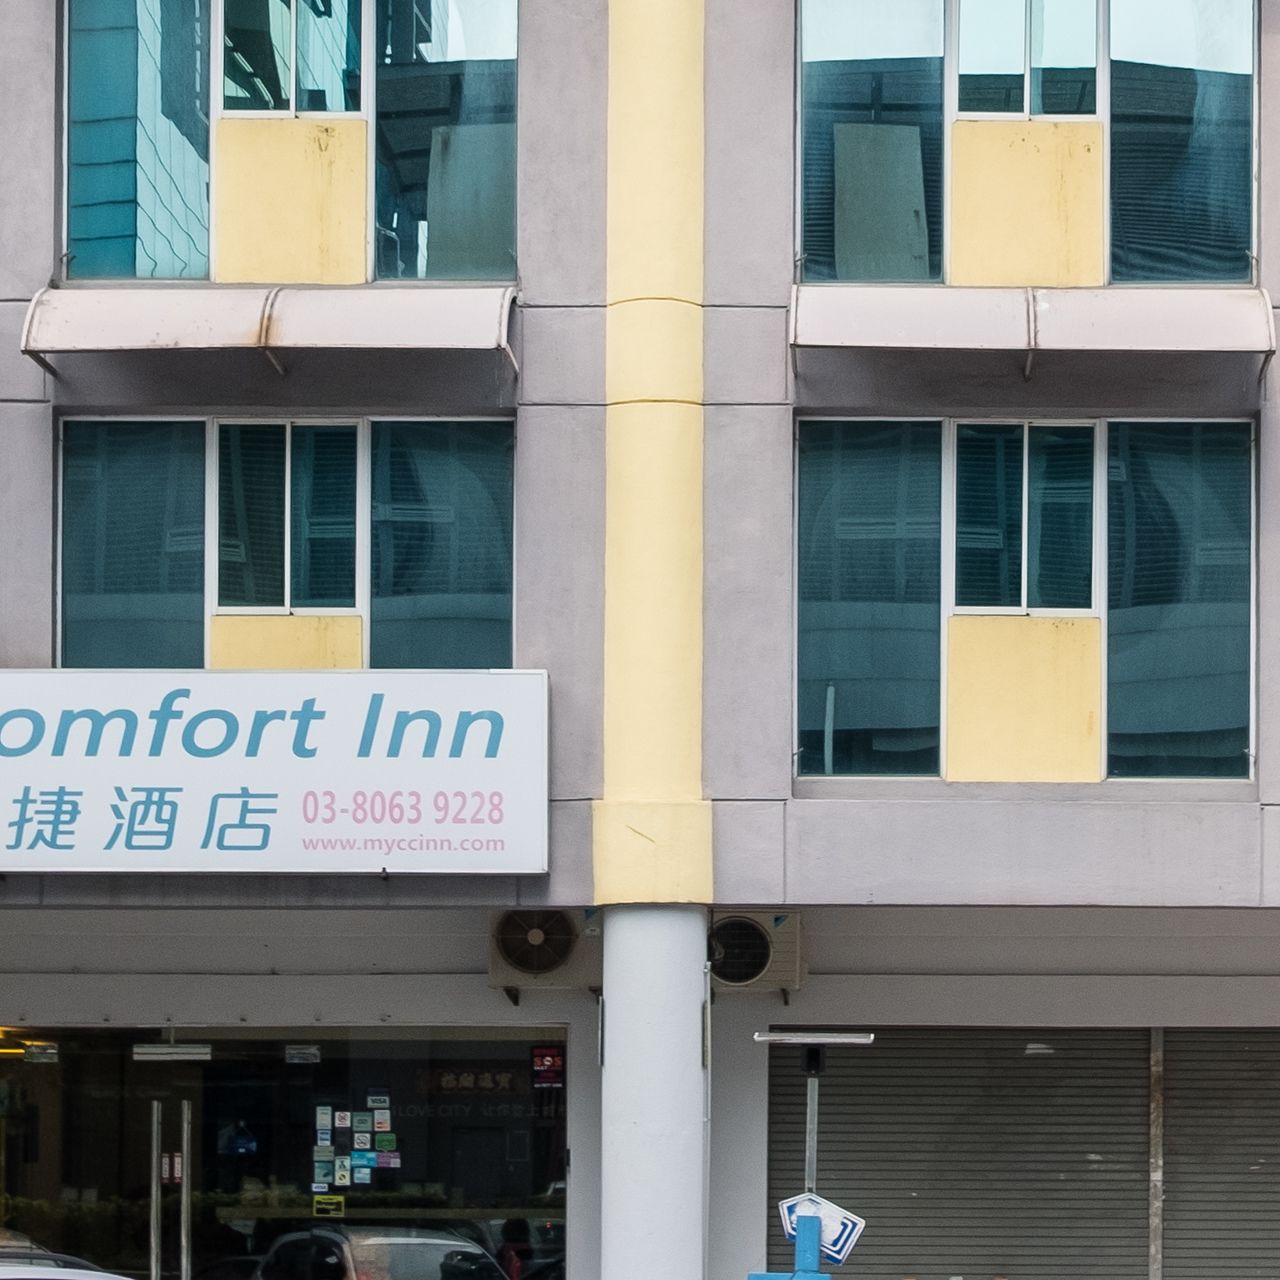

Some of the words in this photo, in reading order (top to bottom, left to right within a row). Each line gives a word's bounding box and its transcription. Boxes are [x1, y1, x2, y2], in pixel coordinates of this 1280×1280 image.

[356, 692, 506, 759] Inn
[302, 790, 422, 825] 03-8063
[433, 790, 505, 826] 9228
[302, 832, 506, 855] www.myccinn.com
